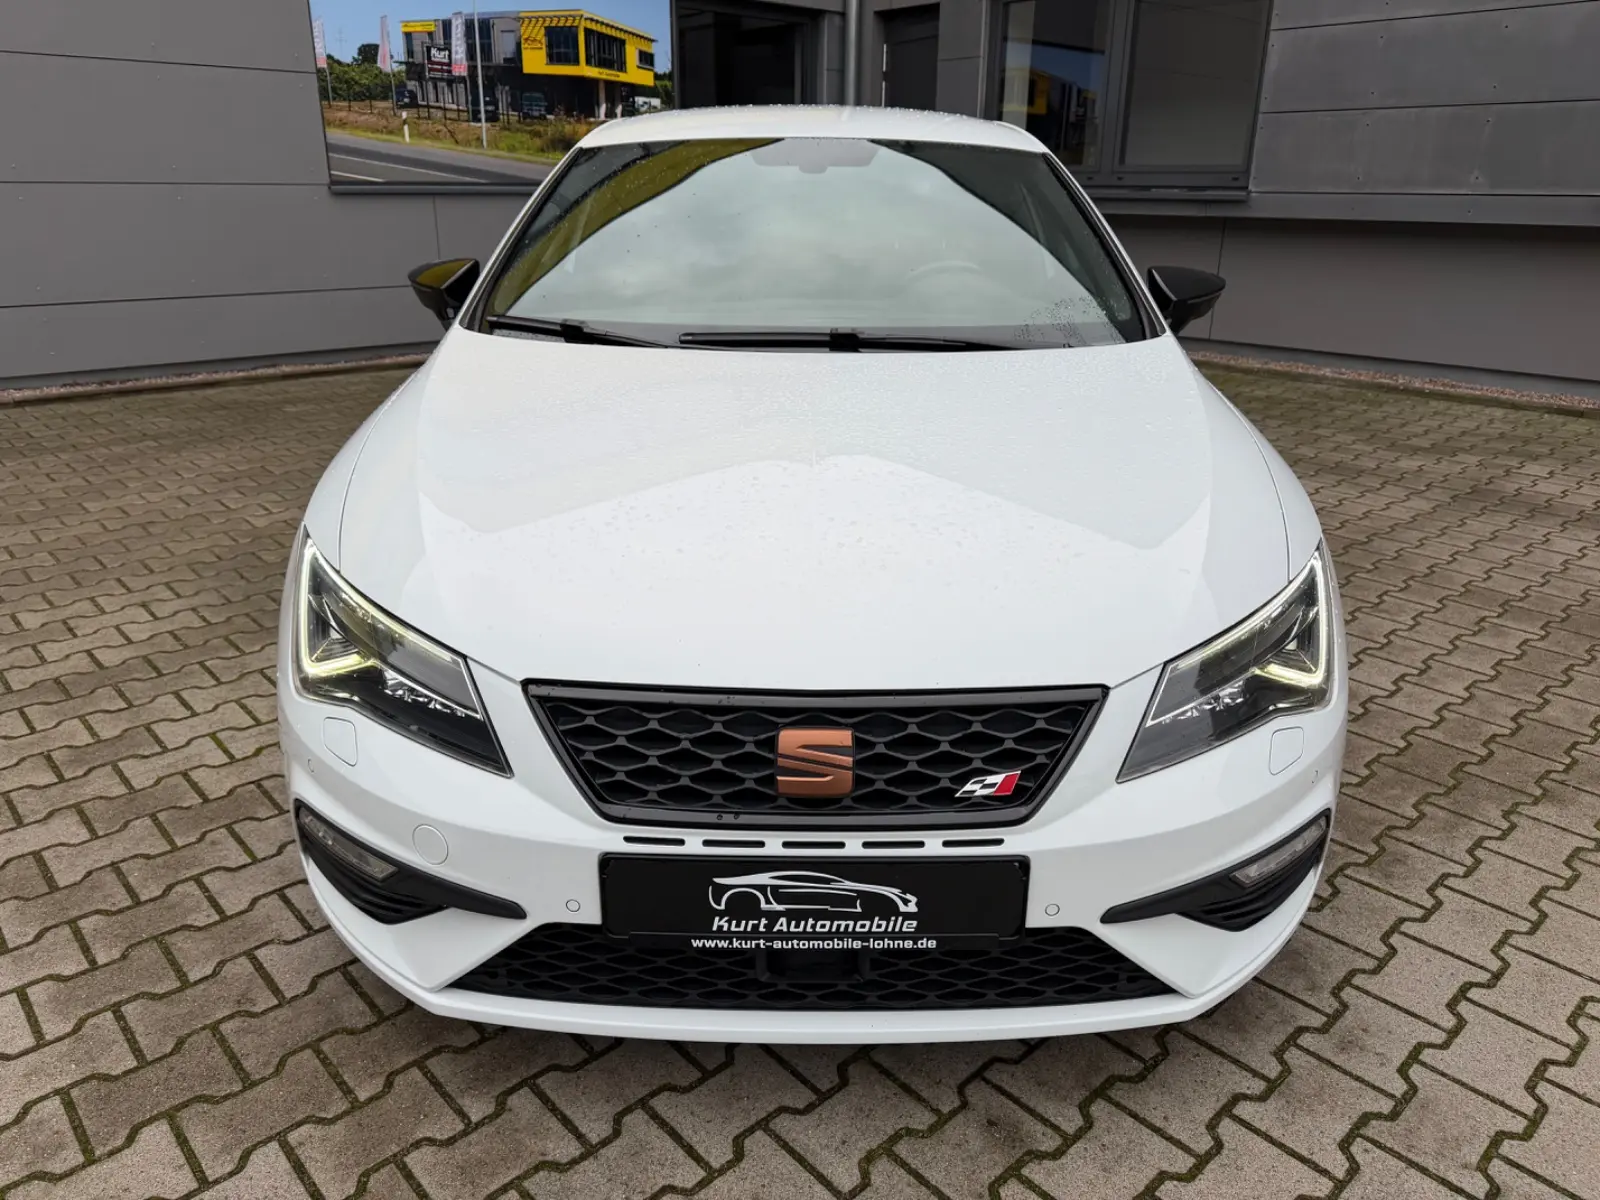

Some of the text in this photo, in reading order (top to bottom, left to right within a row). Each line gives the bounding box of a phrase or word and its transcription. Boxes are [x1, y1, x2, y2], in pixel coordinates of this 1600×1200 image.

[430, 47, 449, 58] Kurt
[712, 916, 918, 933] Kurt Automobile
[691, 937, 937, 950] www.kurt-automobile-lohne.de
